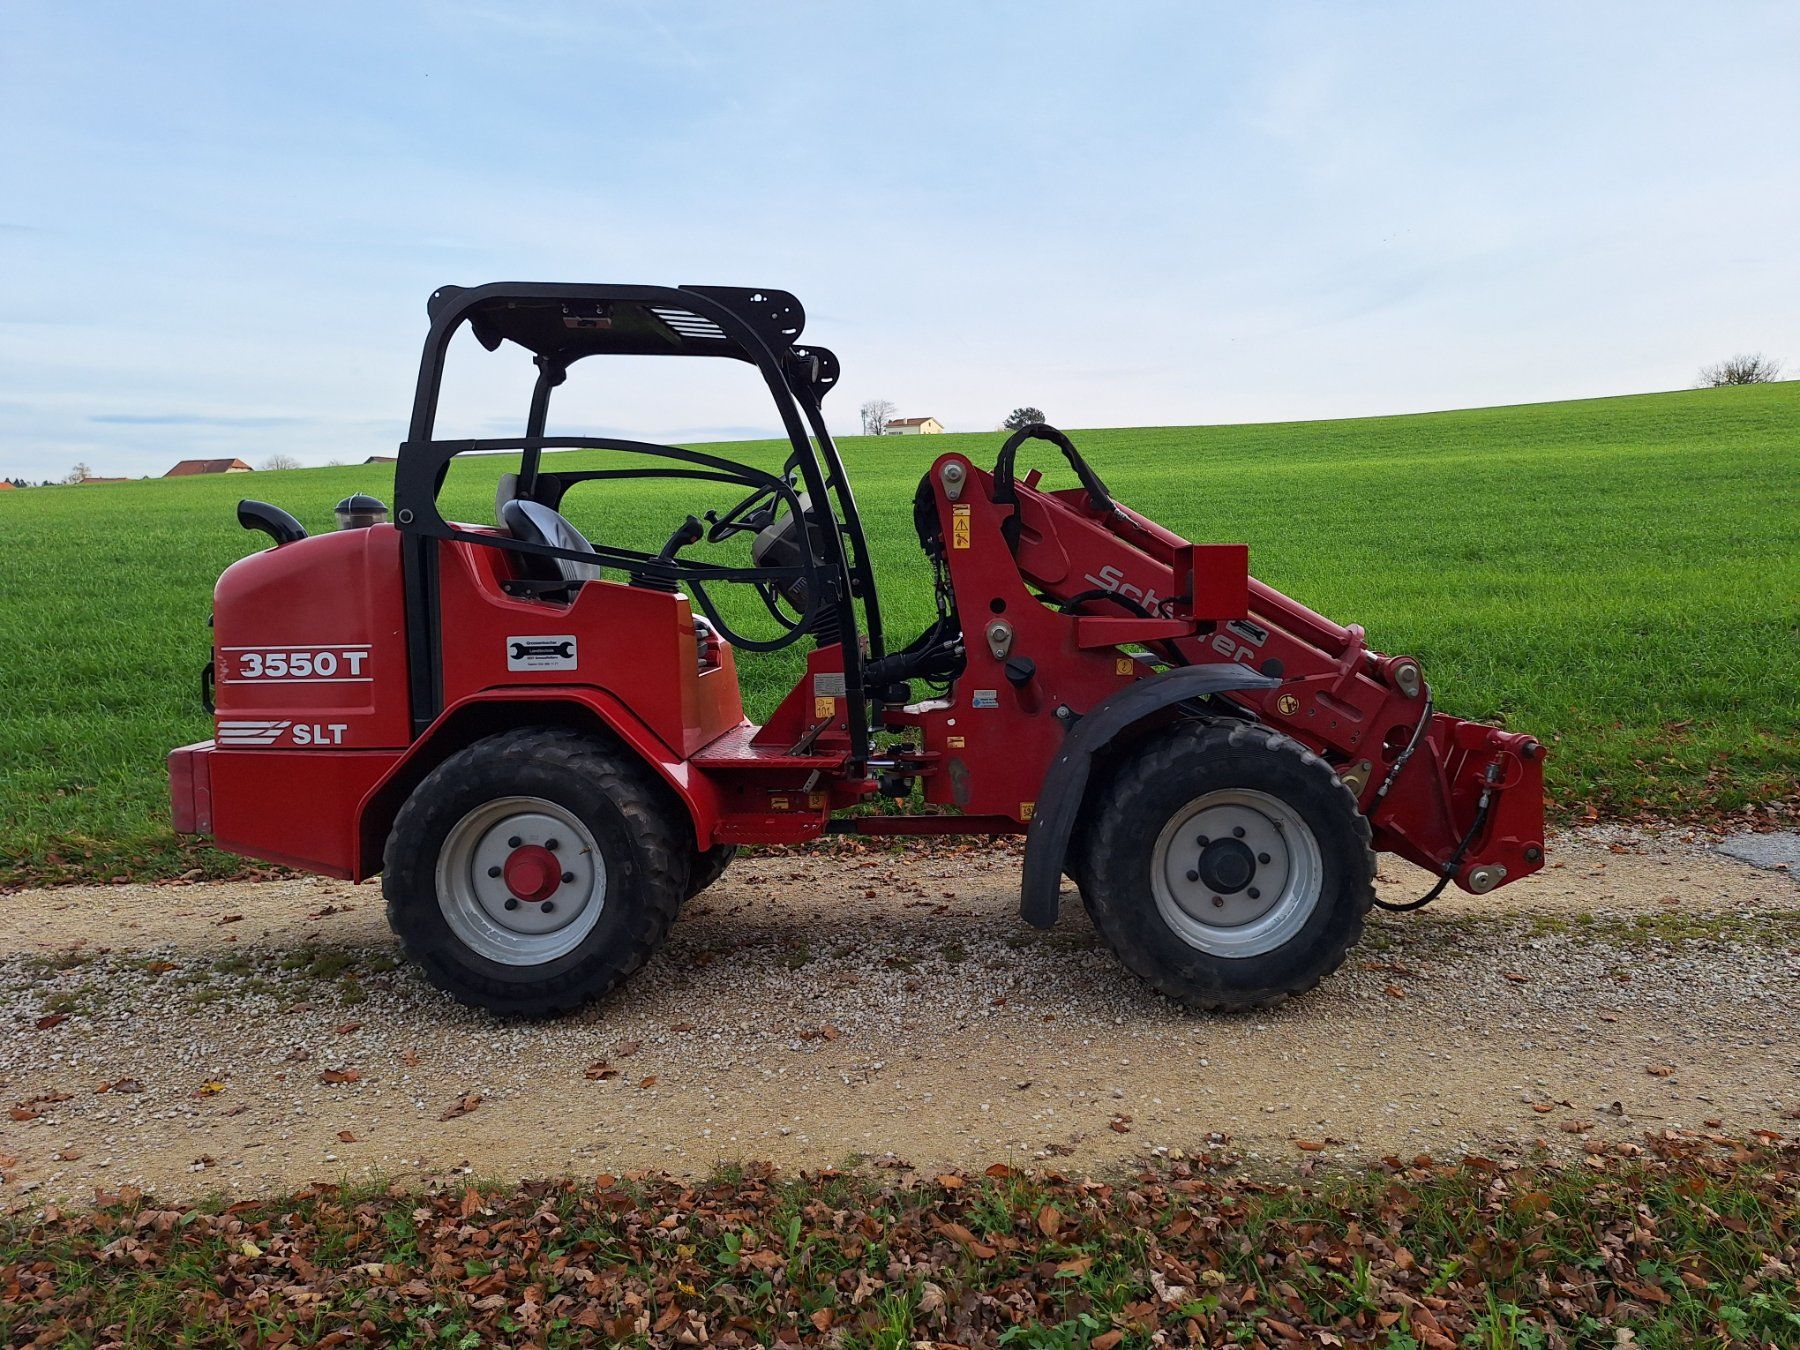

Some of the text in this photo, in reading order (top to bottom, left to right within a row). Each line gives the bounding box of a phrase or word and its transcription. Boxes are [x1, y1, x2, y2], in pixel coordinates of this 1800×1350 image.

[1084, 565, 1254, 662] Scher
[240, 651, 368, 678] 3550 T
[292, 724, 348, 745] SLT
